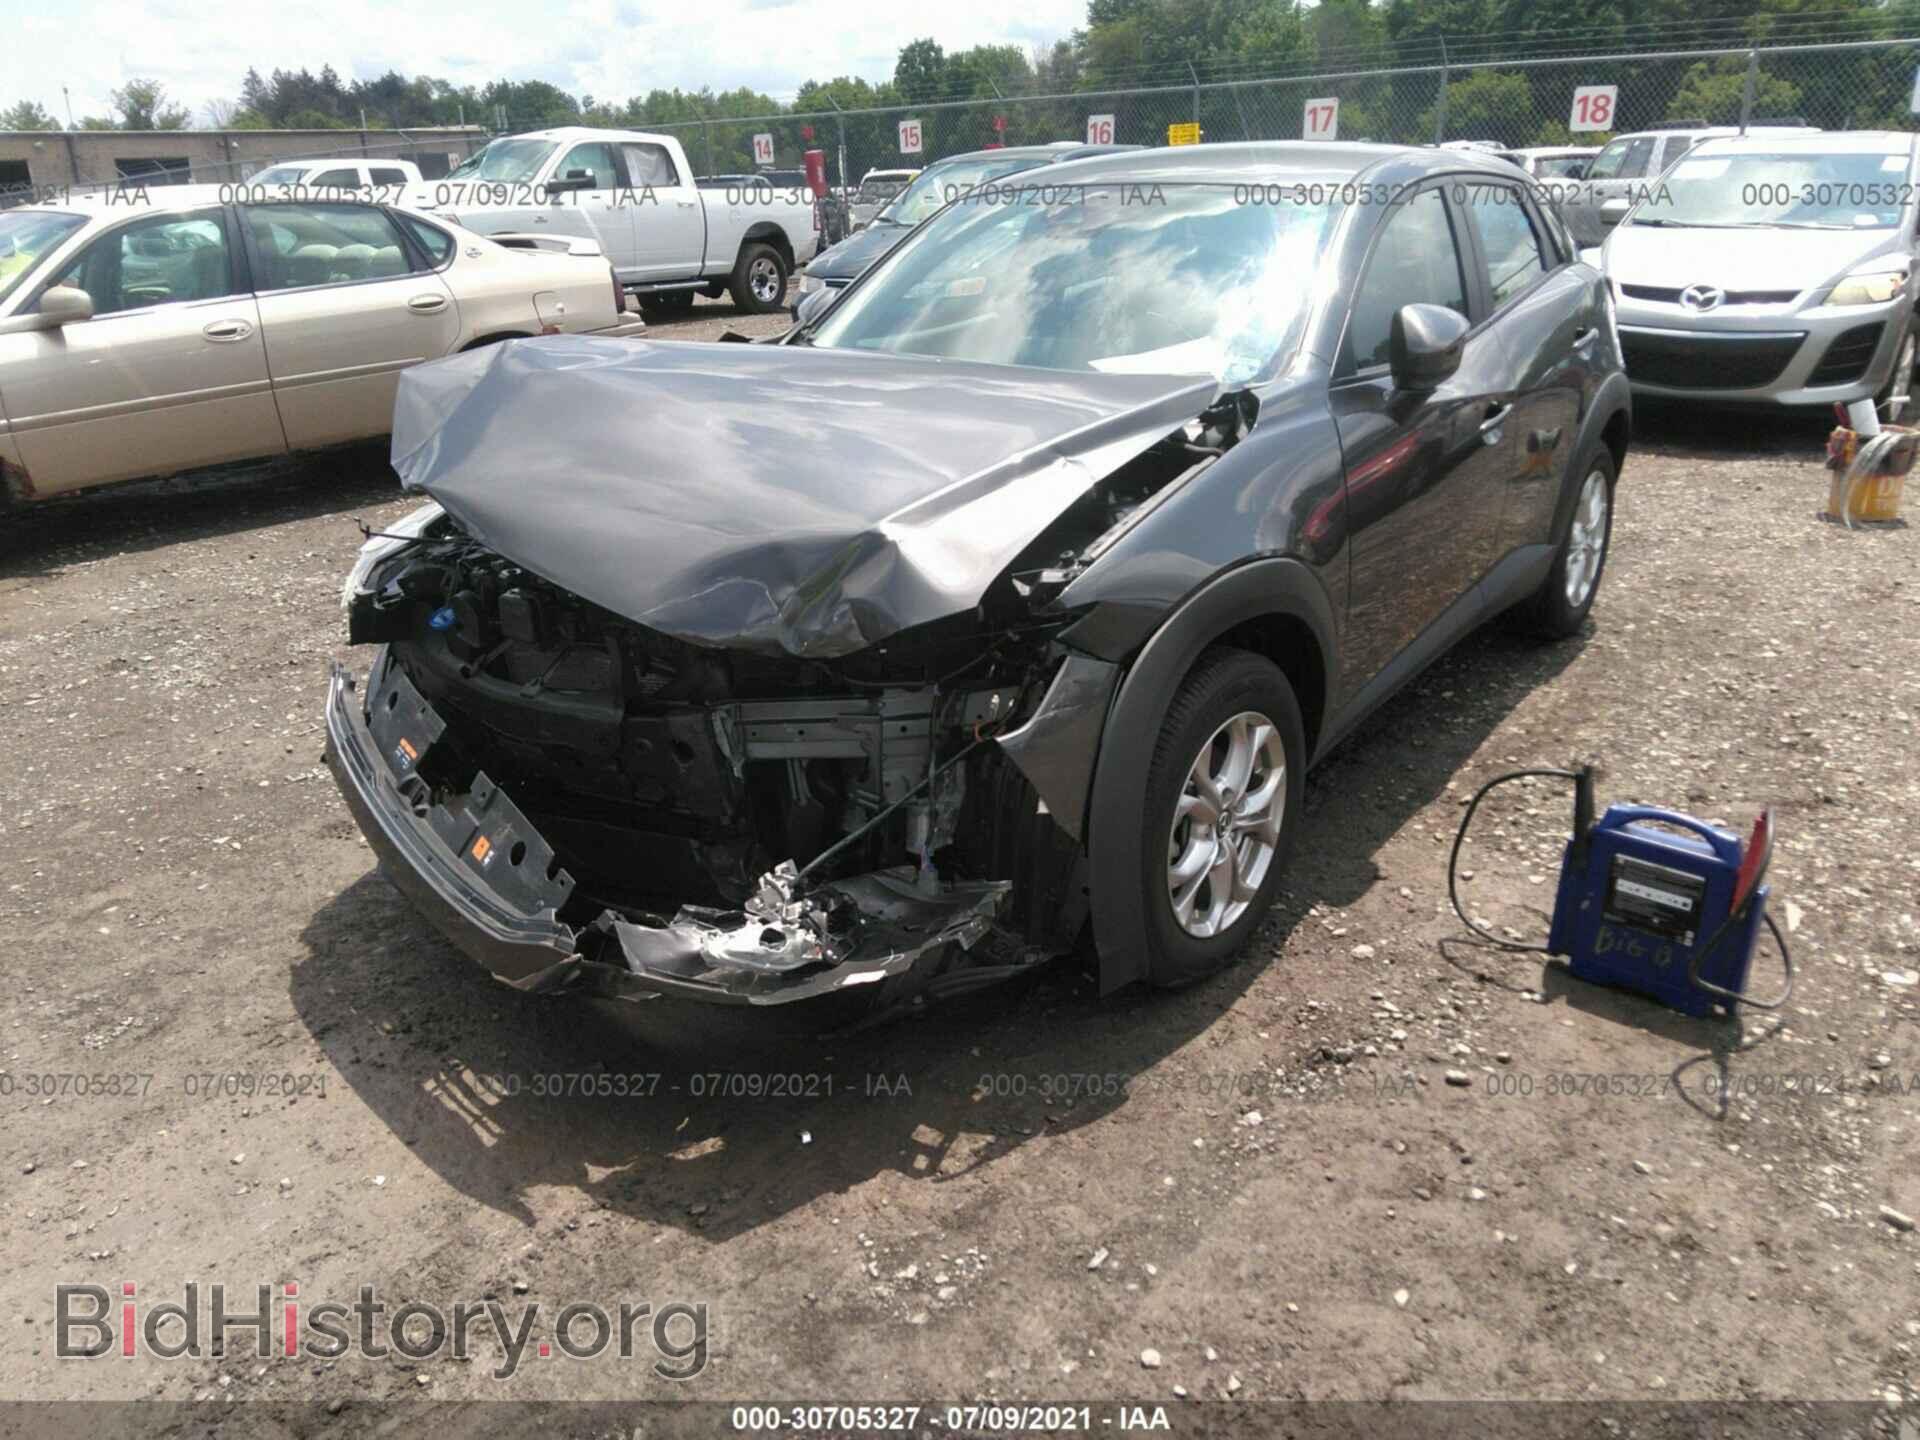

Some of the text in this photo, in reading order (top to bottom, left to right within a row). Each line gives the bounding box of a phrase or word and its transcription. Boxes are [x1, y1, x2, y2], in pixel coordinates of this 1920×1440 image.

[1307, 105, 1335, 132] 17
[1577, 94, 1611, 124] 18
[901, 126, 919, 148] 15
[1090, 120, 1111, 144] 16
[755, 140, 771, 159] 14
